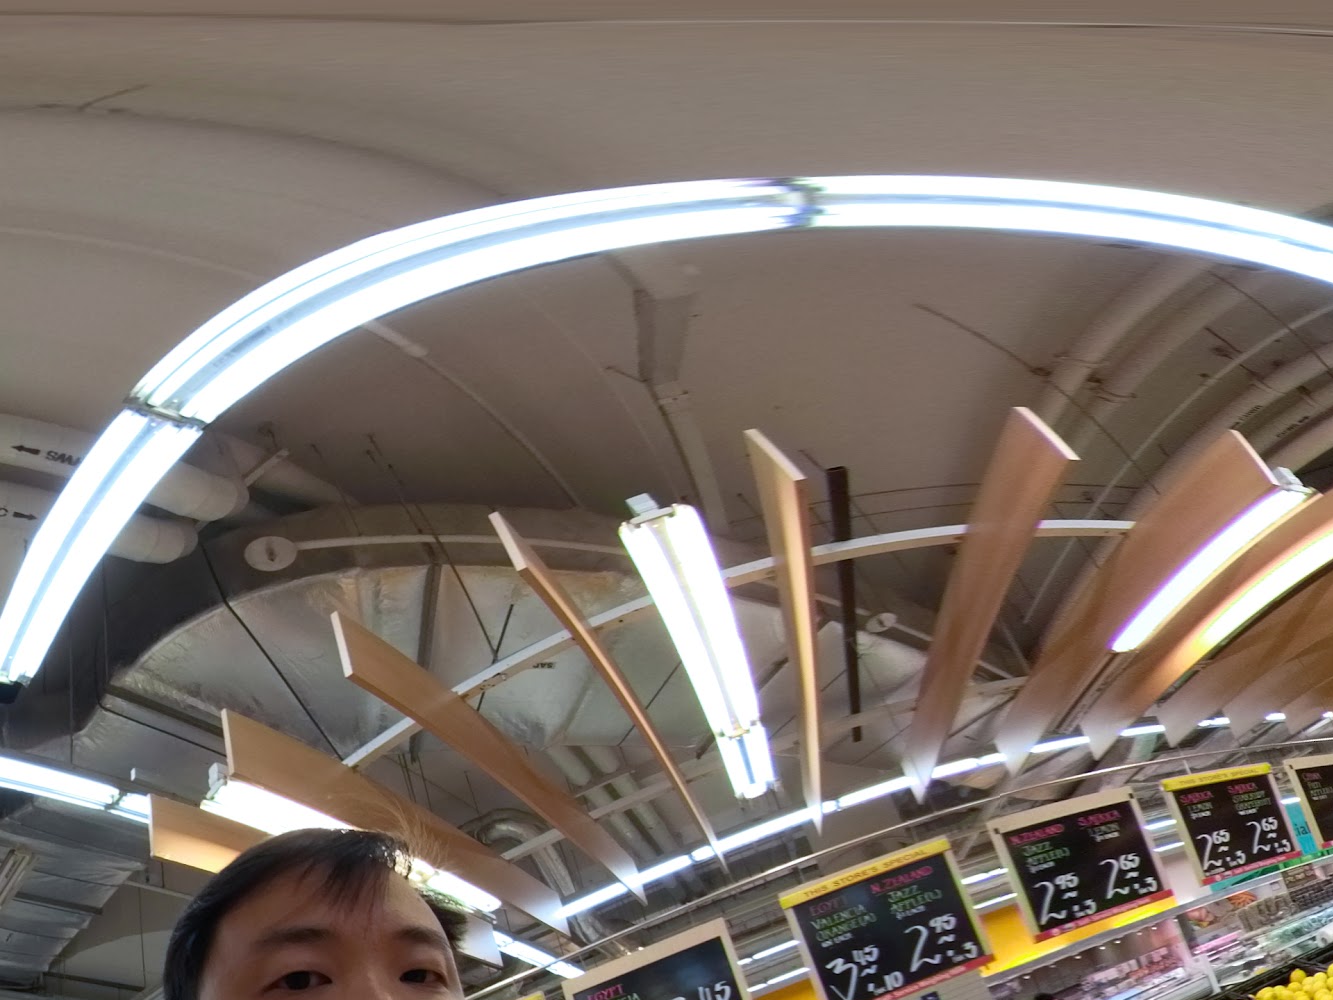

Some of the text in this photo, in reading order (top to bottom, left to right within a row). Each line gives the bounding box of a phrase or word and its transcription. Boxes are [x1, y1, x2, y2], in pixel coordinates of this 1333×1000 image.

[804, 886, 828, 899] THIS
[833, 866, 879, 888] STORE'S
[962, 940, 978, 960] 3
[884, 971, 904, 991] 10
